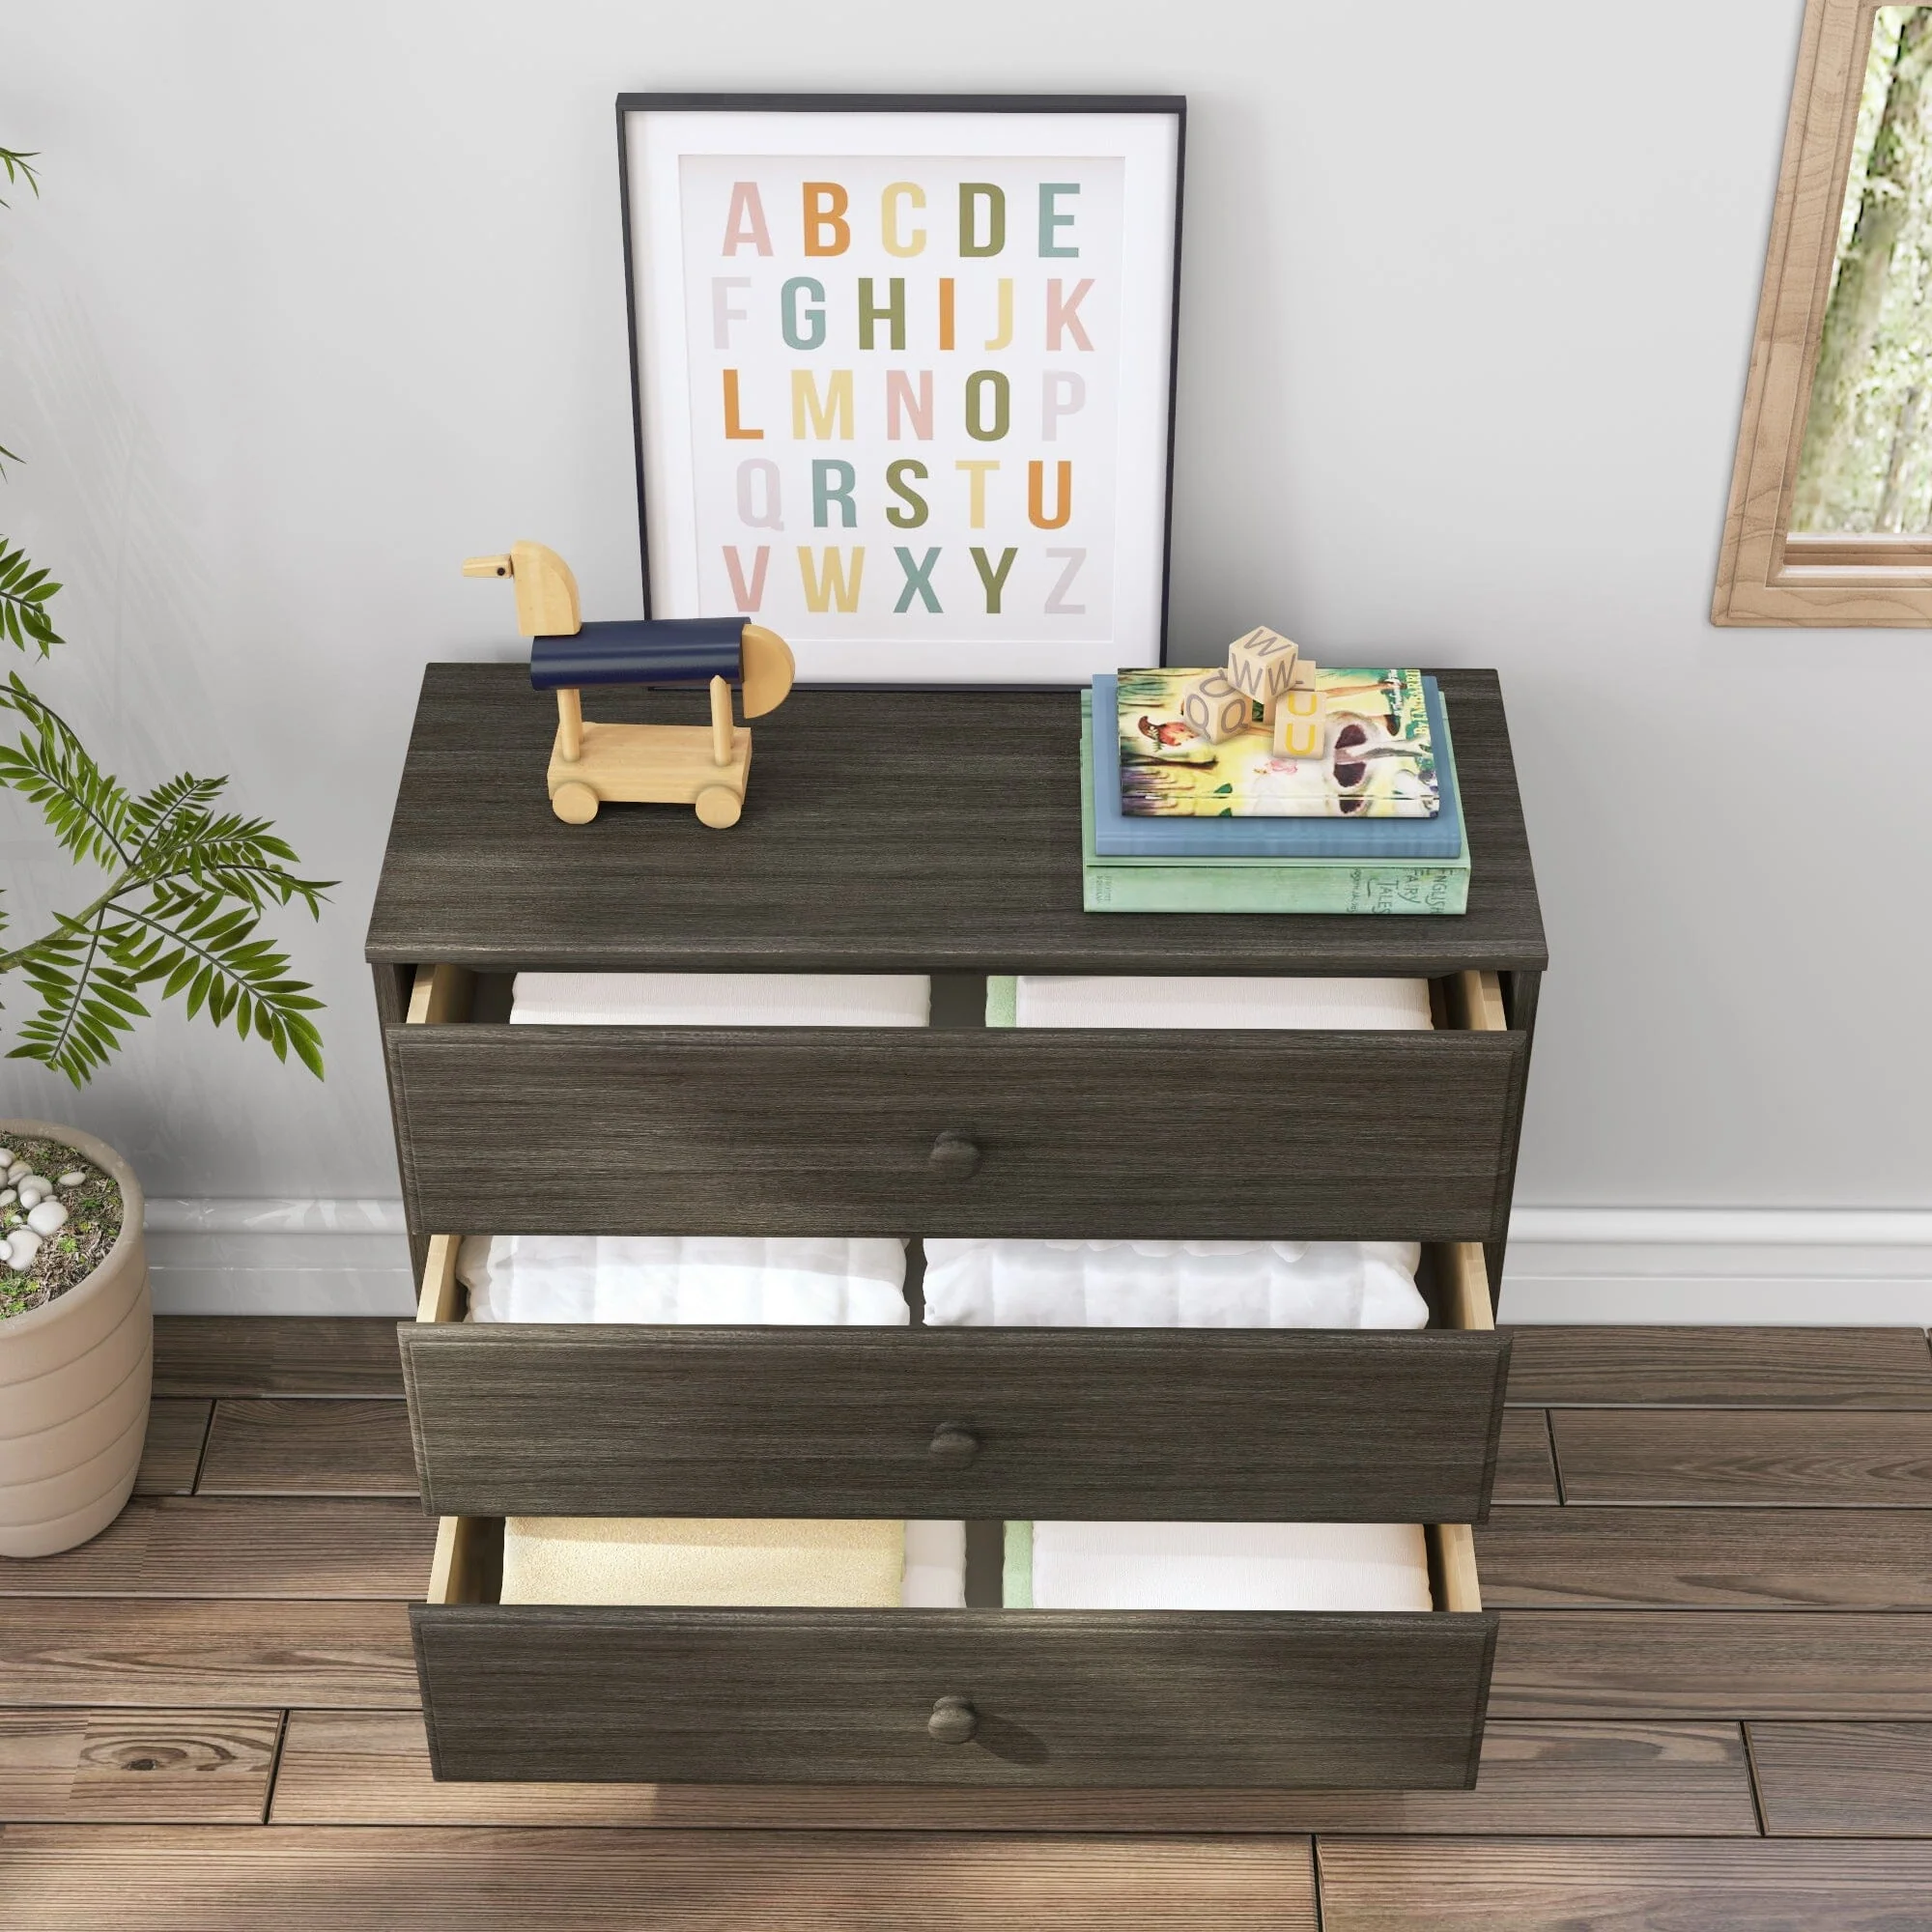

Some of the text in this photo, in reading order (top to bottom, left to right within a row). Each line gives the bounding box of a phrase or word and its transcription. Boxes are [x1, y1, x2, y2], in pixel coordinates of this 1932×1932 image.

[722, 182, 1081, 258] A B C D E
[711, 276, 1095, 352] F G H I J K
[723, 368, 1086, 441] L M N O P
[735, 458, 1072, 531] Q R S T U
[722, 545, 1087, 614] V W X Y Z
[1232, 653, 1264, 696] W
[1267, 653, 1296, 696] W
[1221, 698, 1249, 733] Q
[1285, 723, 1316, 755] U
[1372, 877, 1400, 914] TALES
[1398, 868, 1424, 904] FAIRY
[1425, 868, 1453, 914] ENGLISH
